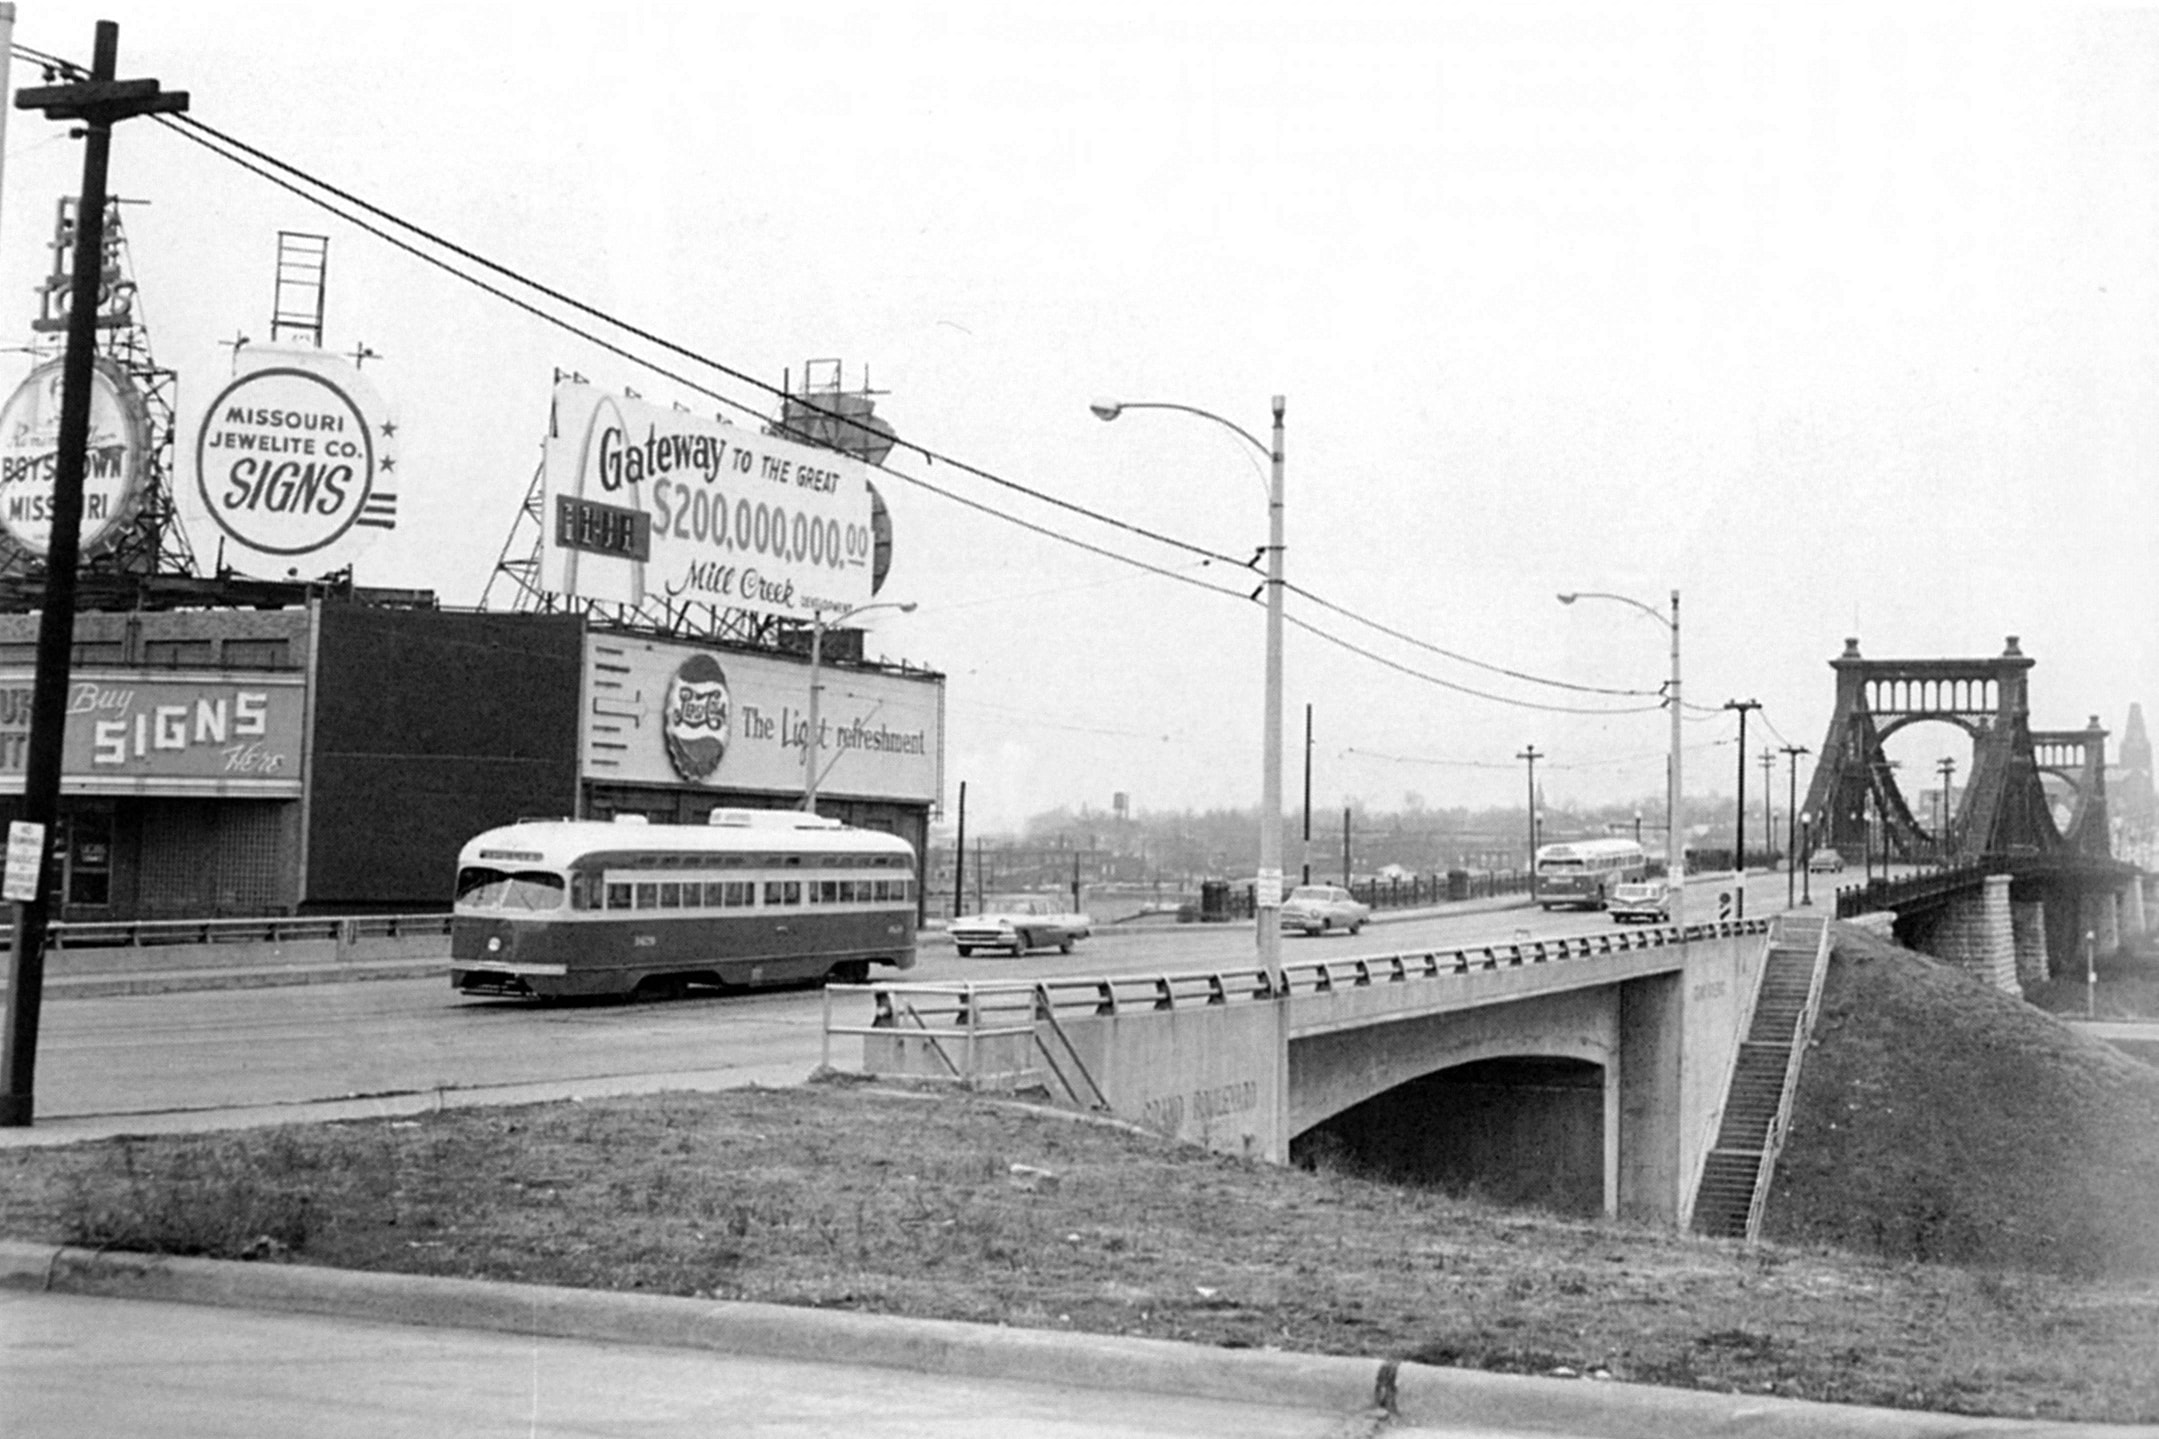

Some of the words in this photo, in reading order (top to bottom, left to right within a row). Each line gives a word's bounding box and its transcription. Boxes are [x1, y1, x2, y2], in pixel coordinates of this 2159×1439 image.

[225, 406, 344, 432] MISSOURI
[83, 450, 122, 480] OWN
[209, 431, 316, 455] JEWELITE
[325, 440, 364, 459] CO.
[599, 422, 727, 492] Gateway
[733, 448, 753, 473] TO
[762, 455, 790, 484] THE
[796, 464, 841, 495] GREAT
[8, 493, 108, 522] MISSRI
[223, 456, 354, 516] SIGNS
[665, 559, 735, 597] Mill
[740, 567, 794, 609] Creek
[66, 682, 135, 719] Buy
[93, 691, 268, 764] SIGNS
[742, 706, 775, 740] The
[781, 706, 833, 767] Ligt
[836, 716, 925, 755] refreshment
